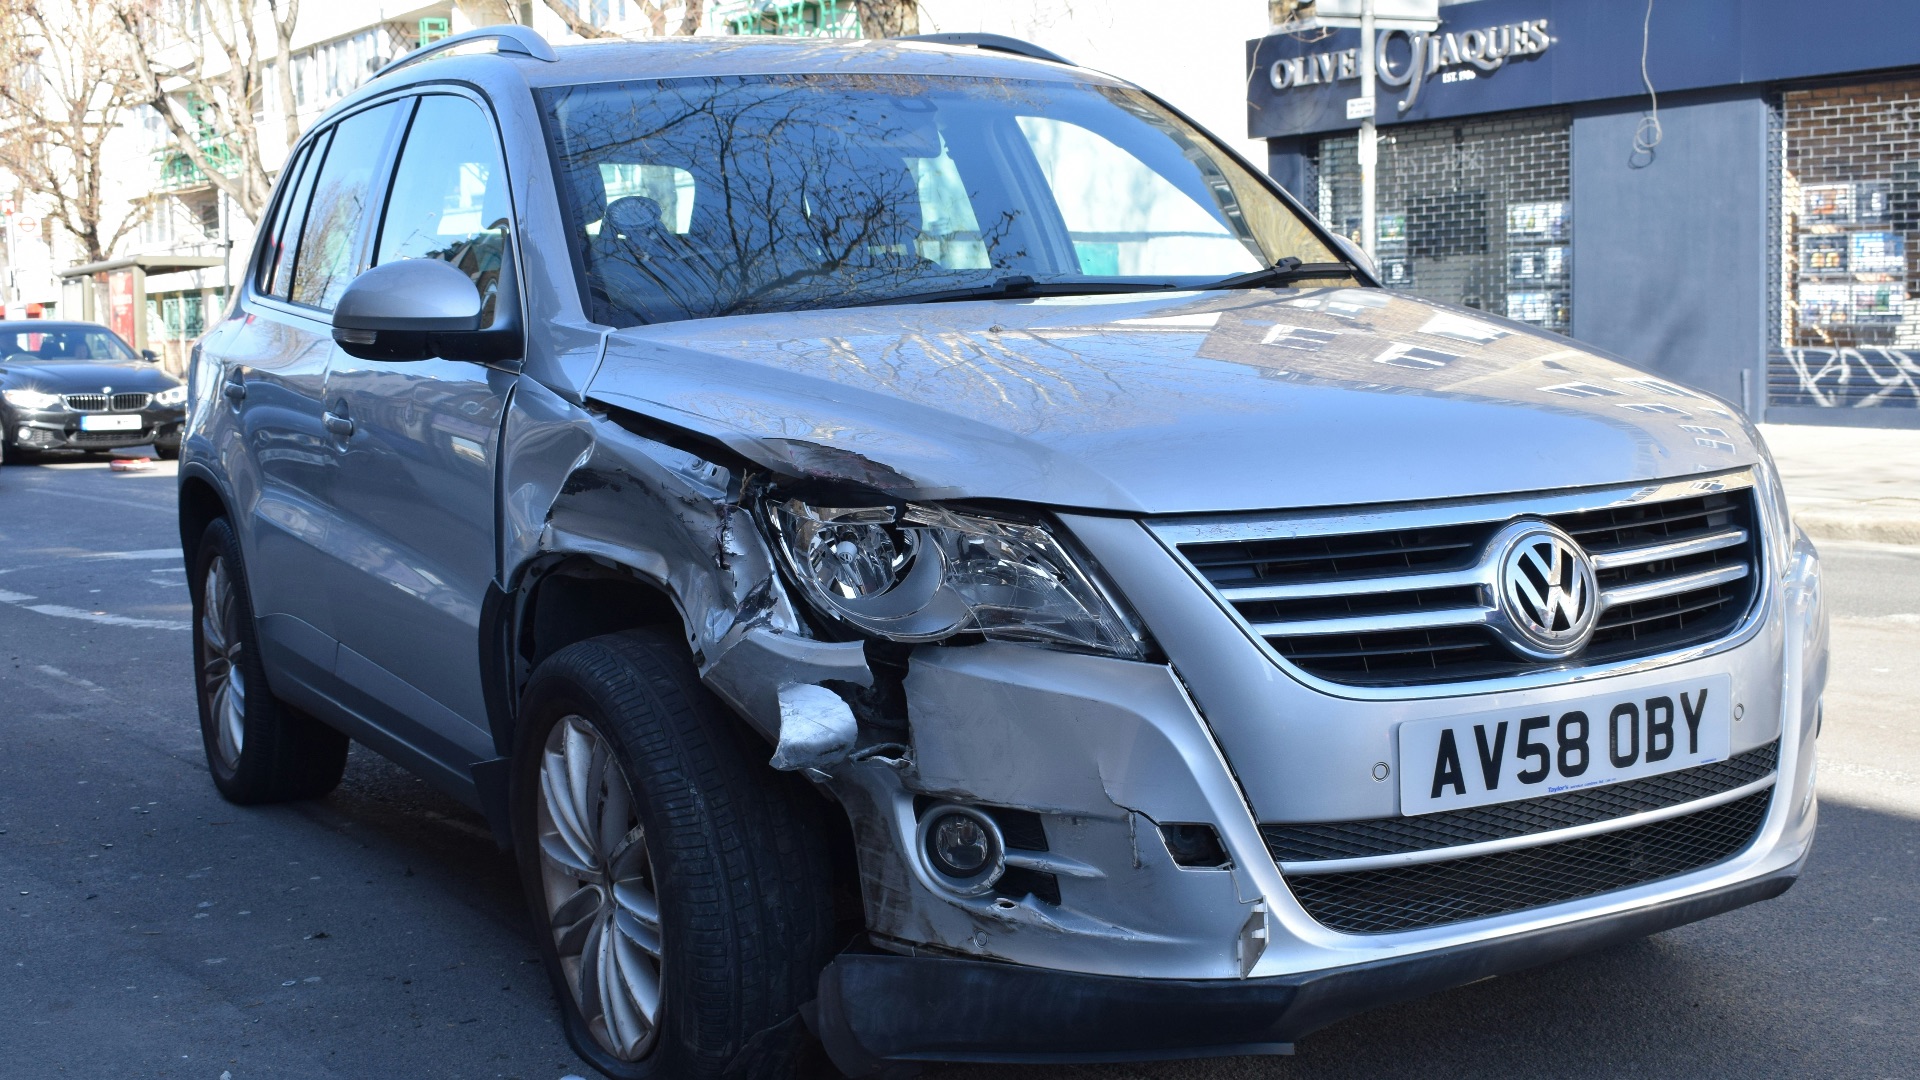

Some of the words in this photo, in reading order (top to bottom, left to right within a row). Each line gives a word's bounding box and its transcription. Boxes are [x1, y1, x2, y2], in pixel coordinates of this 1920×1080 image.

[1426, 19, 1549, 75] JAQUES
[1506, 532, 1591, 638] VW
[1431, 711, 1589, 798] AV58
[1609, 688, 1708, 769] OBY
[1548, 784, 1569, 793] Taylor's
